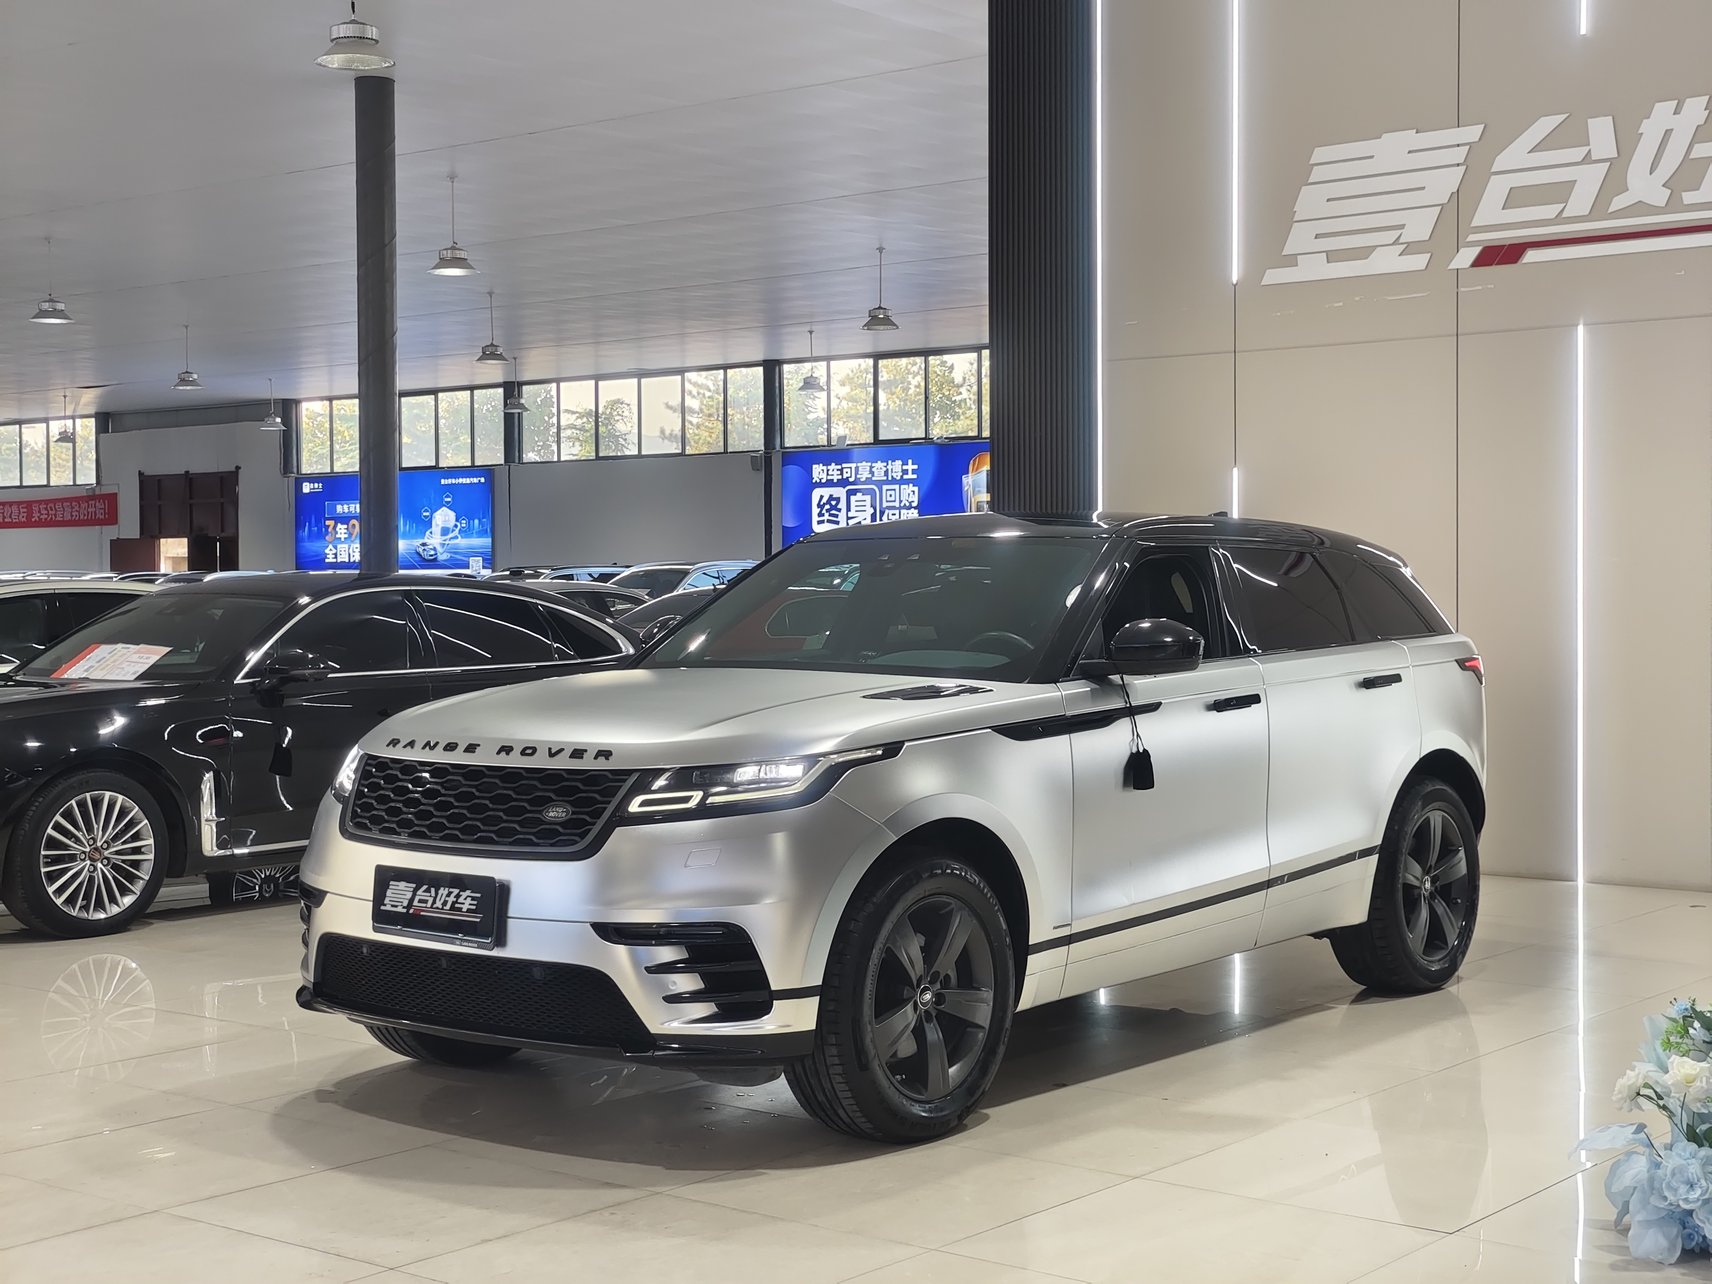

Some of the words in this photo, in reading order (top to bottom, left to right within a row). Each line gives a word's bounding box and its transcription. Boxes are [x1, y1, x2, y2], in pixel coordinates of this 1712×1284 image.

[812, 459, 919, 483] 购车可享查博士
[882, 483, 919, 507] 回购
[816, 492, 875, 525] 终身
[386, 738, 481, 754] RANGE
[496, 744, 614, 761] ROVER
[380, 880, 482, 913] 壹台好车
